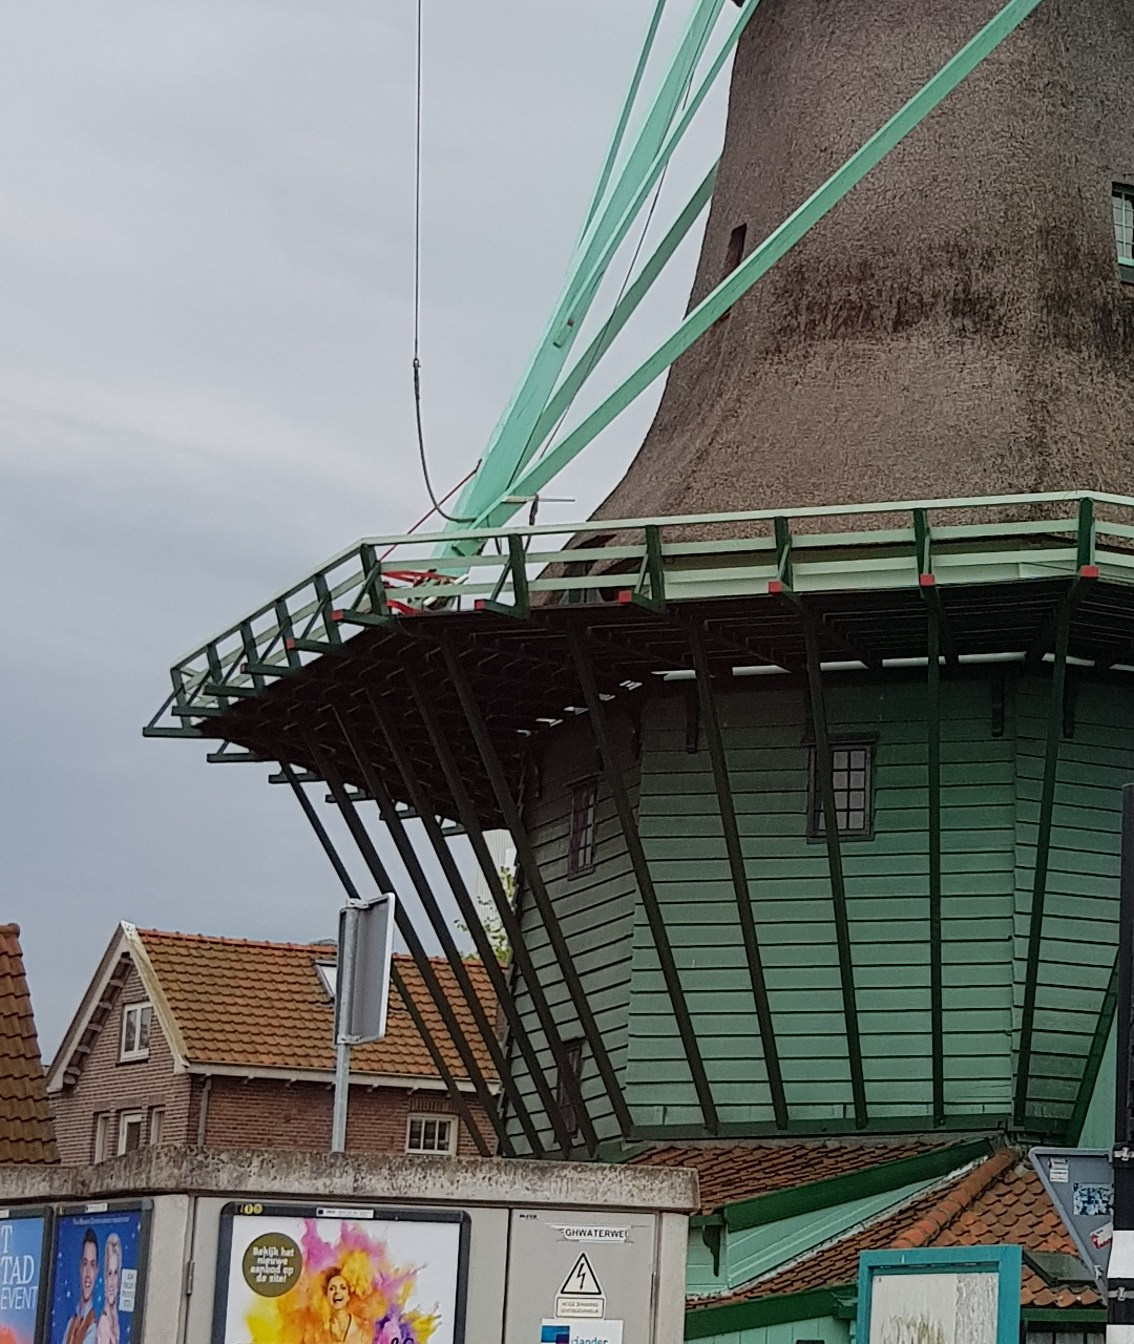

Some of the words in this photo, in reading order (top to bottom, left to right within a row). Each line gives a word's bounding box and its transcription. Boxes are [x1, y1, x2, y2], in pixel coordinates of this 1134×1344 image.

[253, 1246, 278, 1258] Bekijk
[281, 1246, 294, 1257] het
[251, 1264, 280, 1274] aanbod
[282, 1267, 294, 1276] op
[256, 1273, 267, 1282] de
[269, 1274, 287, 1283] site!
